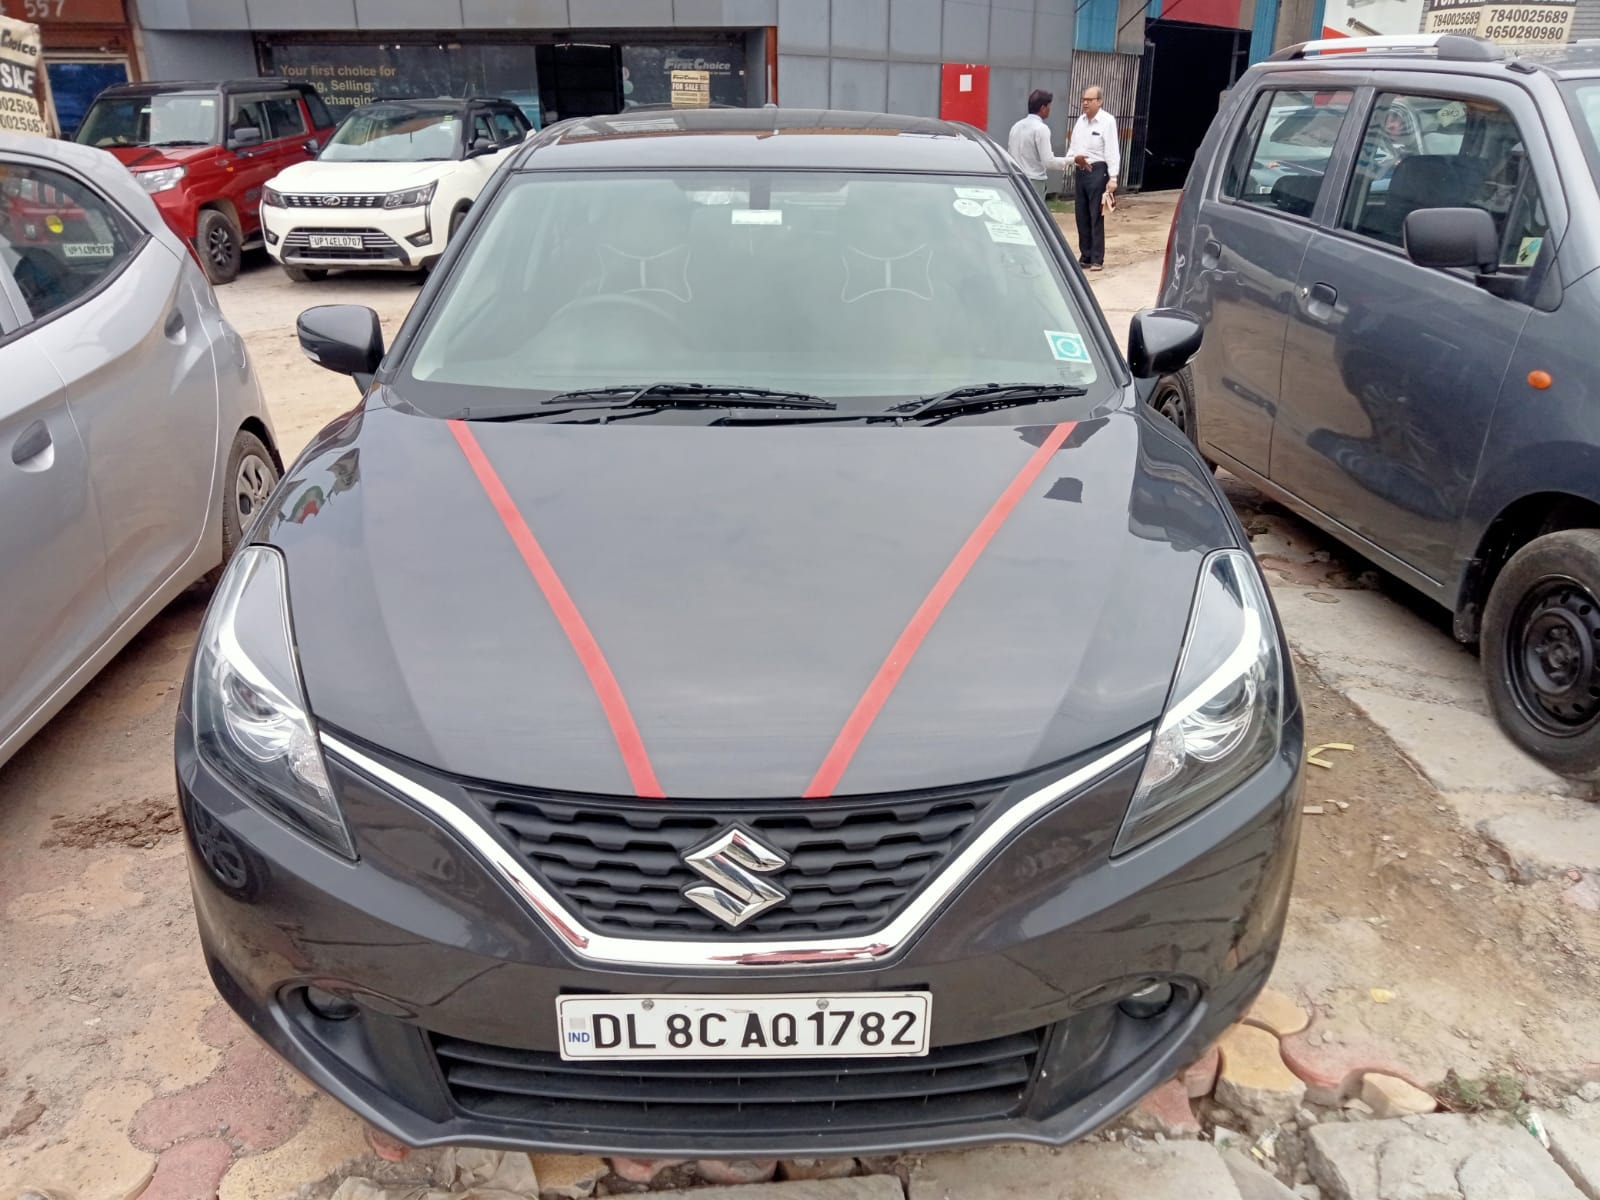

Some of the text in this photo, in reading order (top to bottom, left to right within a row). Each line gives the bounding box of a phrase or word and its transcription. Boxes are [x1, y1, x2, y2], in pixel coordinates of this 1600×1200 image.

[1433, 11, 1480, 27] 7840025689
[1490, 9, 1568, 24] 7840025689
[1485, 25, 1564, 40] 9650280980
[280, 64, 396, 77] Your first choice for
[330, 80, 375, 93] Selling,
[568, 1032, 590, 1044] IND
